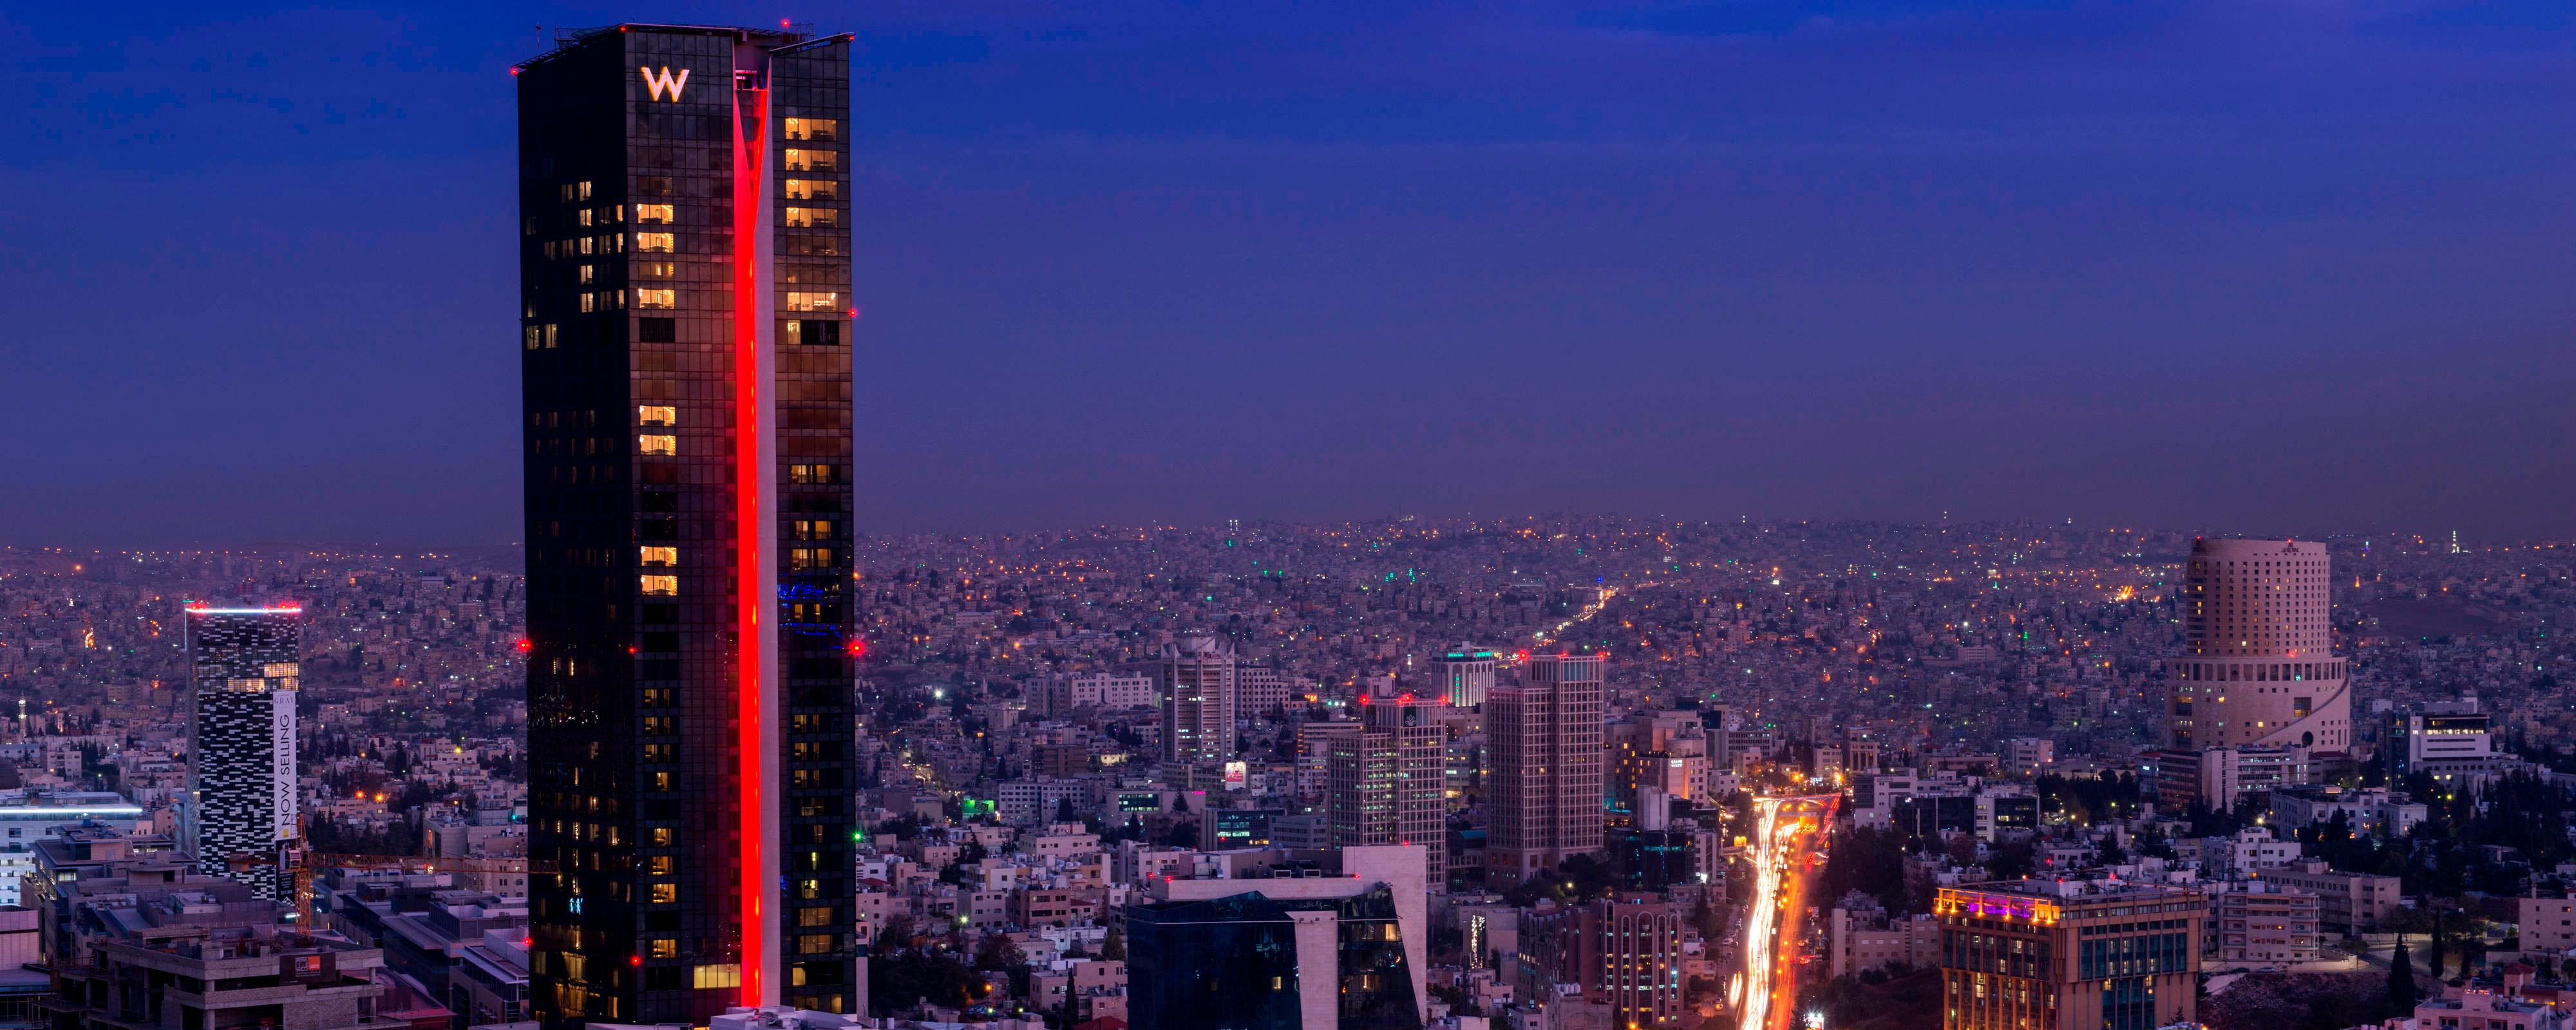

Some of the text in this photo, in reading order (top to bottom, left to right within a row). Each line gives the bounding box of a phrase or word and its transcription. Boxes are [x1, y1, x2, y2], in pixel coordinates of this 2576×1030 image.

[640, 66, 690, 103] W
[280, 714, 290, 826] NOW SELLING
